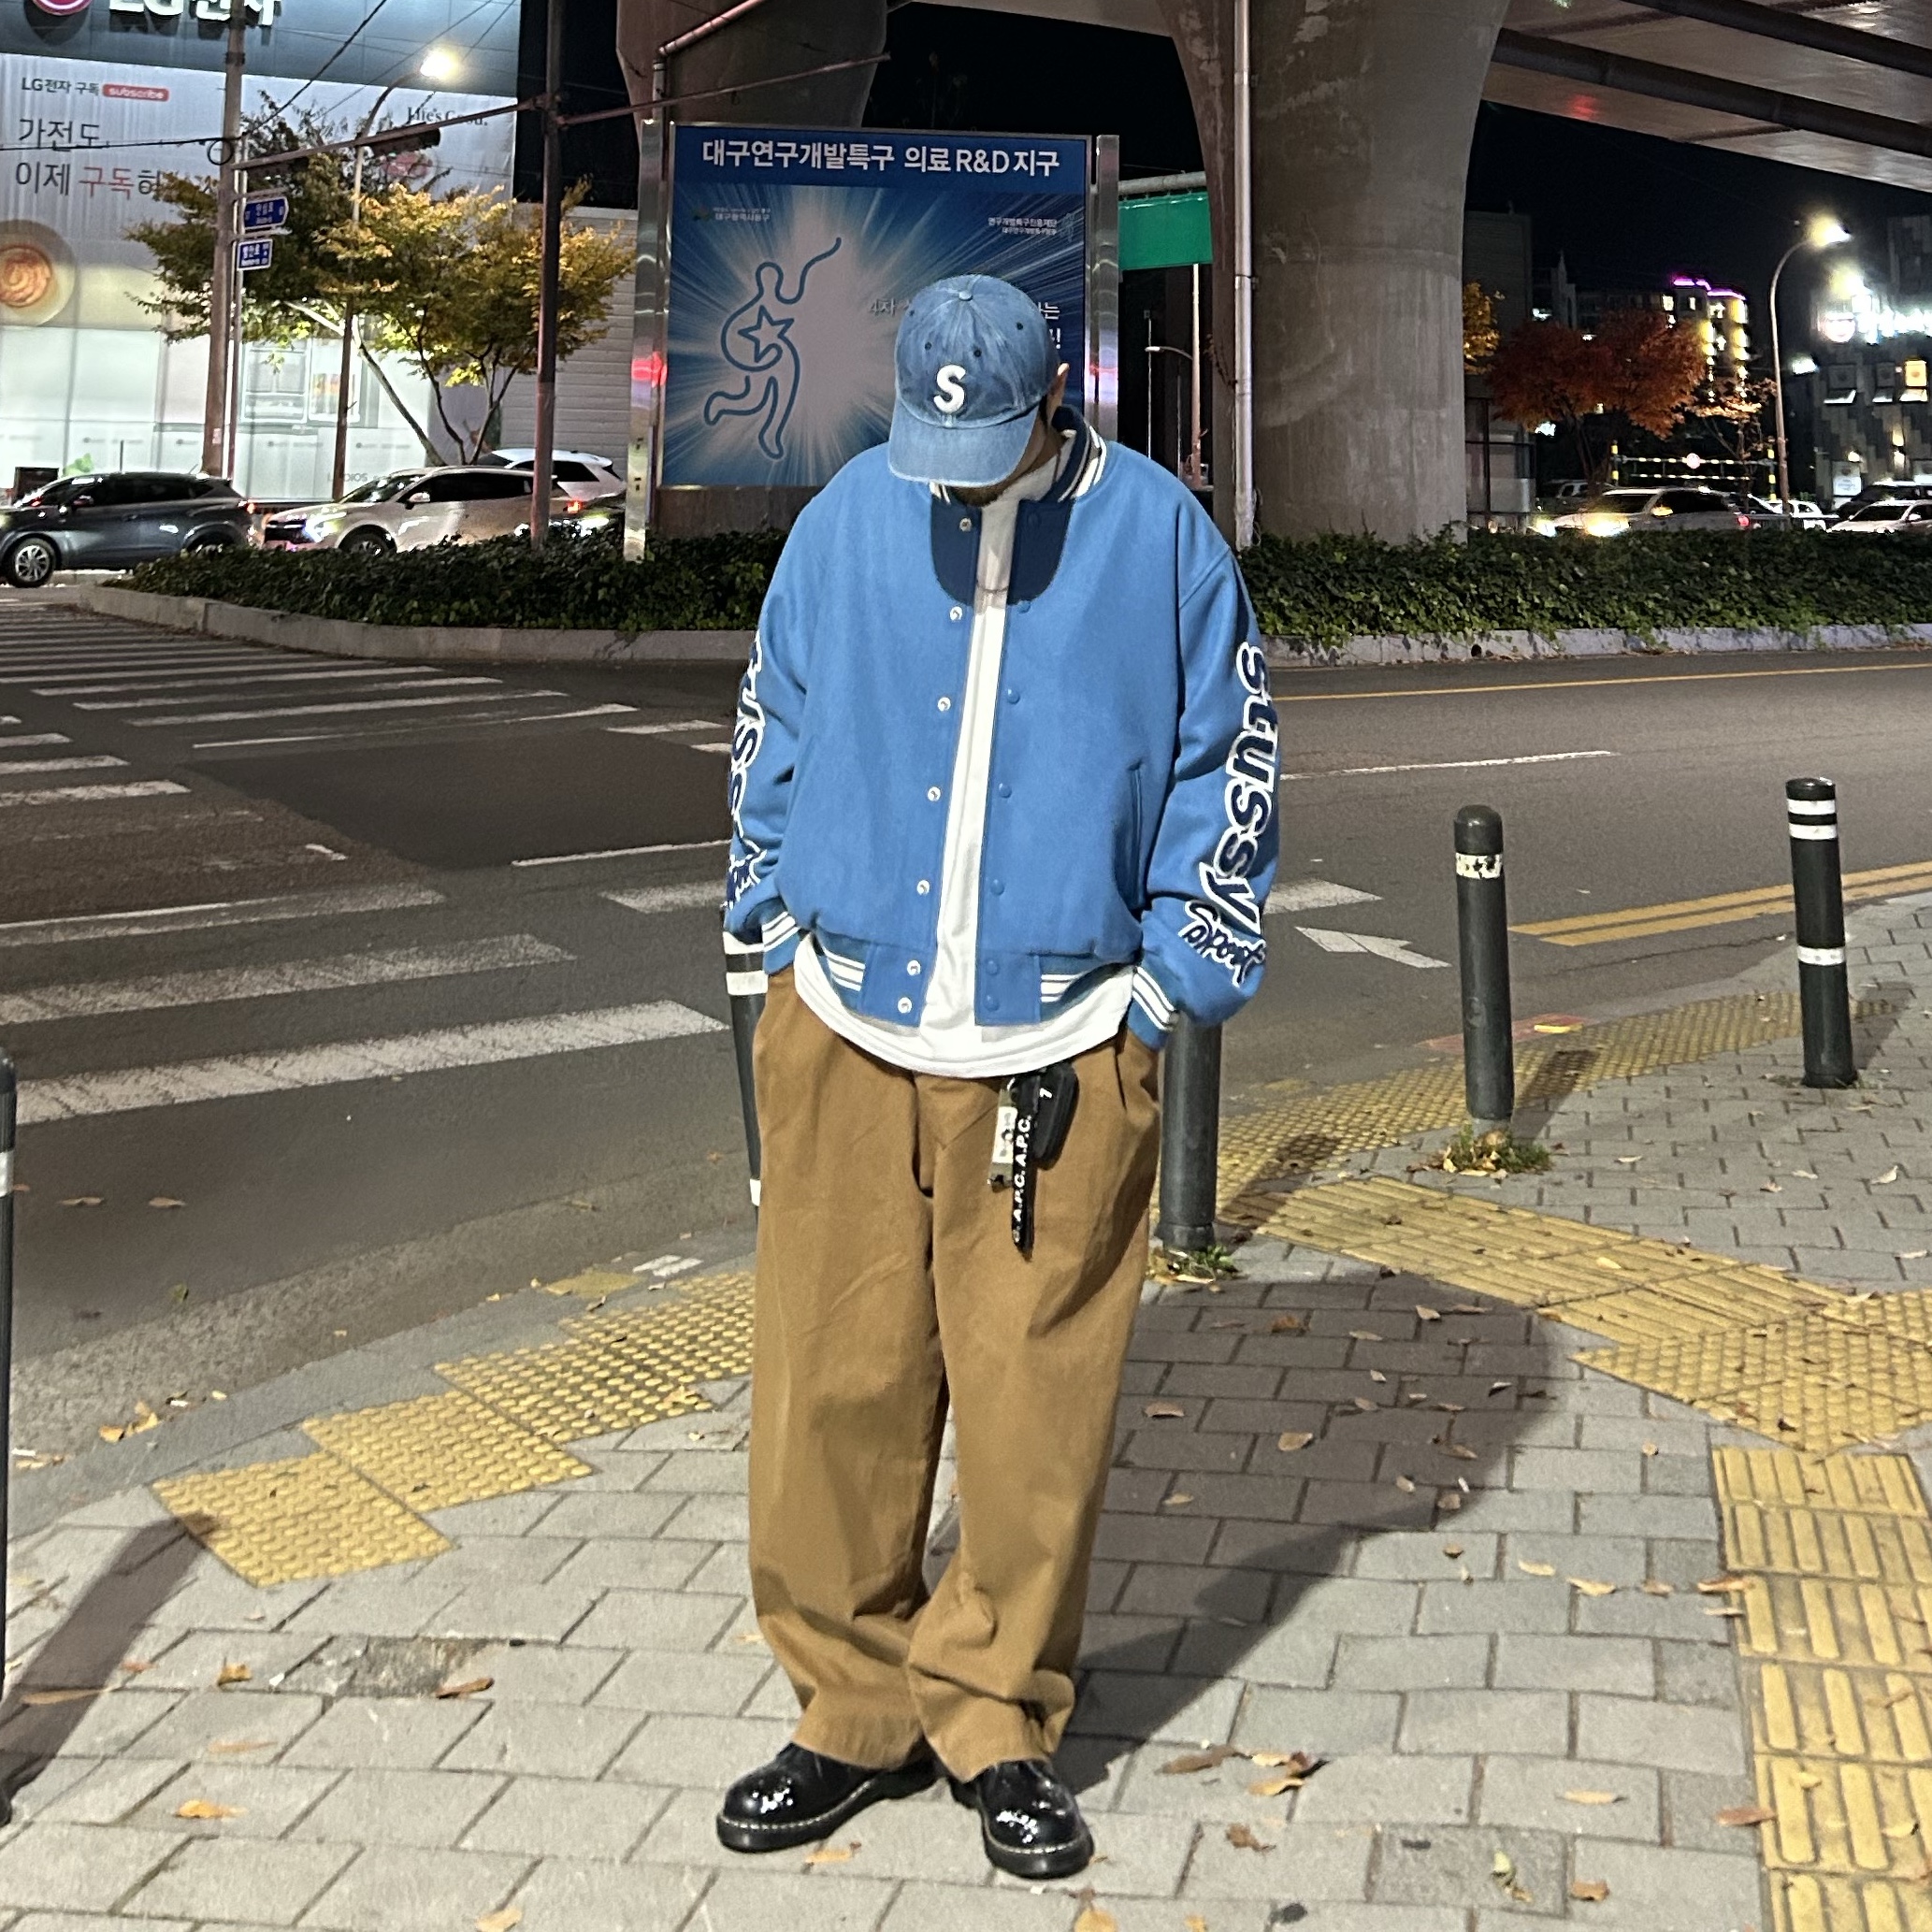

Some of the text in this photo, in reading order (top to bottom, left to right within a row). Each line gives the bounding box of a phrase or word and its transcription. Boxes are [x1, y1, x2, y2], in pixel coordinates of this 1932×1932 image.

[22, 77, 72, 94] LG전자
[77, 81, 100, 96] 구독
[19, 118, 100, 152] 가전도
[702, 139, 1060, 177] 대구연구개발특구 의료 R&D 지구
[16, 161, 71, 196] 이제
[933, 364, 967, 413] S
[1015, 1114, 1032, 1168] A.P.C.
